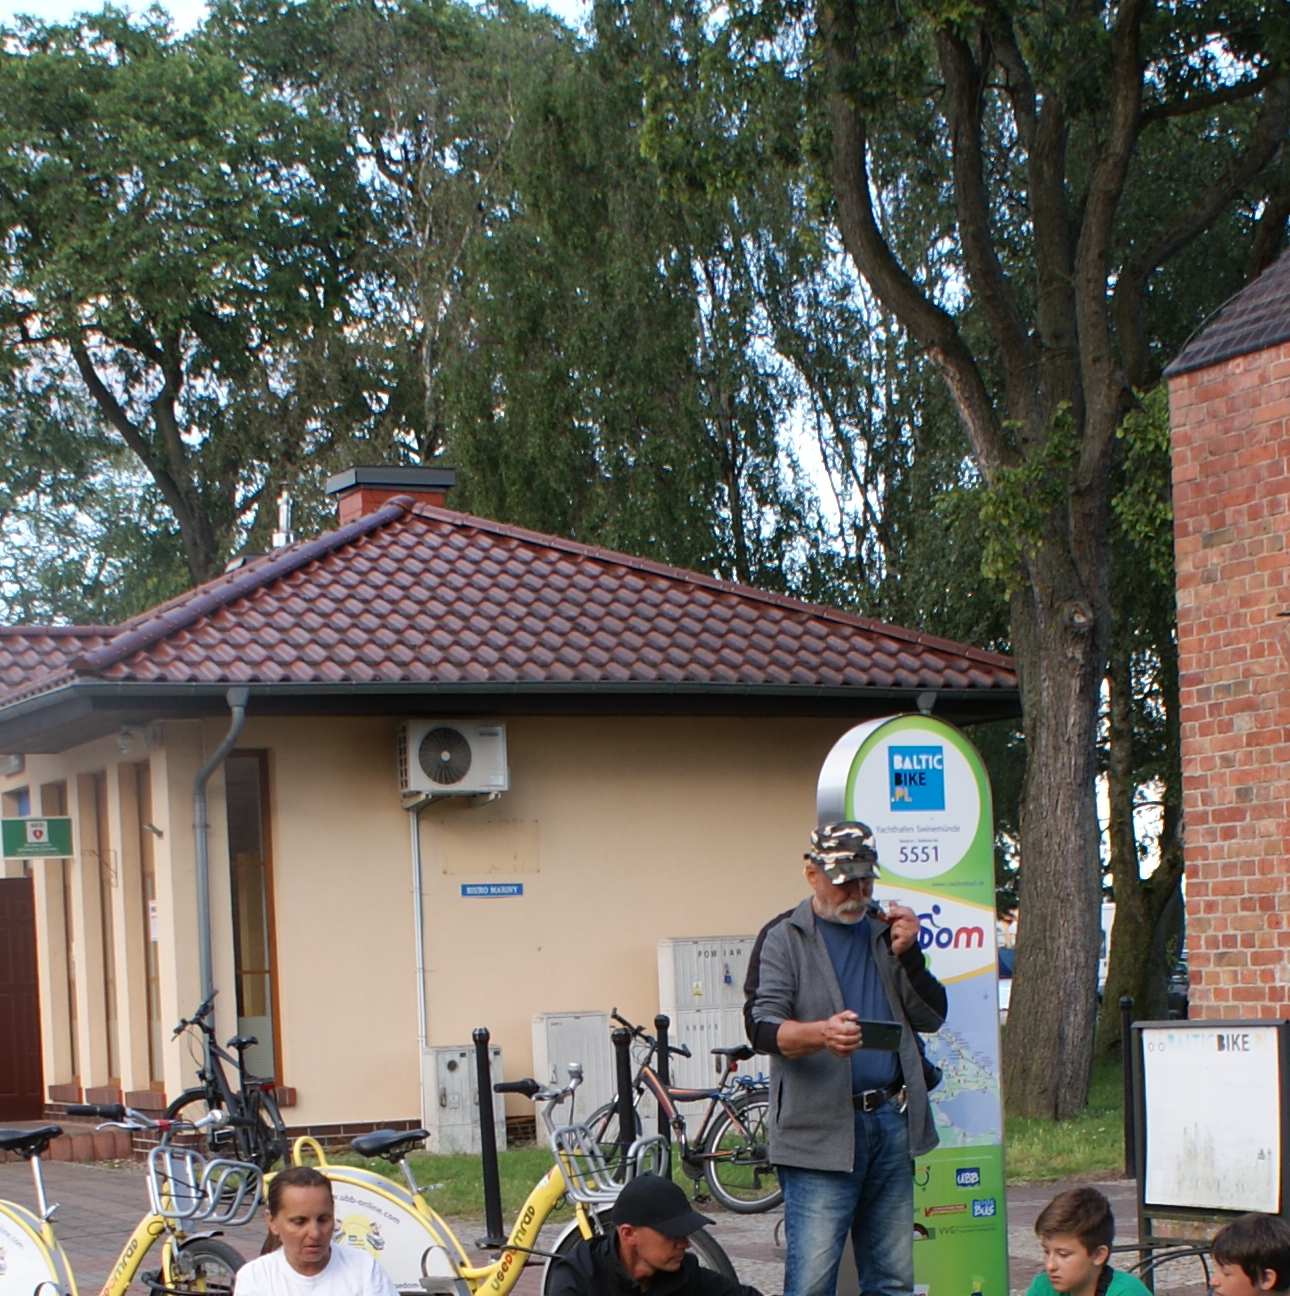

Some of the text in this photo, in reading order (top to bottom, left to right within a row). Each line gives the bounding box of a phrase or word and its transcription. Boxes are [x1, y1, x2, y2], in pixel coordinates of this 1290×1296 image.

[893, 754, 943, 770] BALTIC
[894, 772, 926, 786] BIKE
[899, 846, 939, 863] 5551
[1217, 1034, 1250, 1052] BIKE
